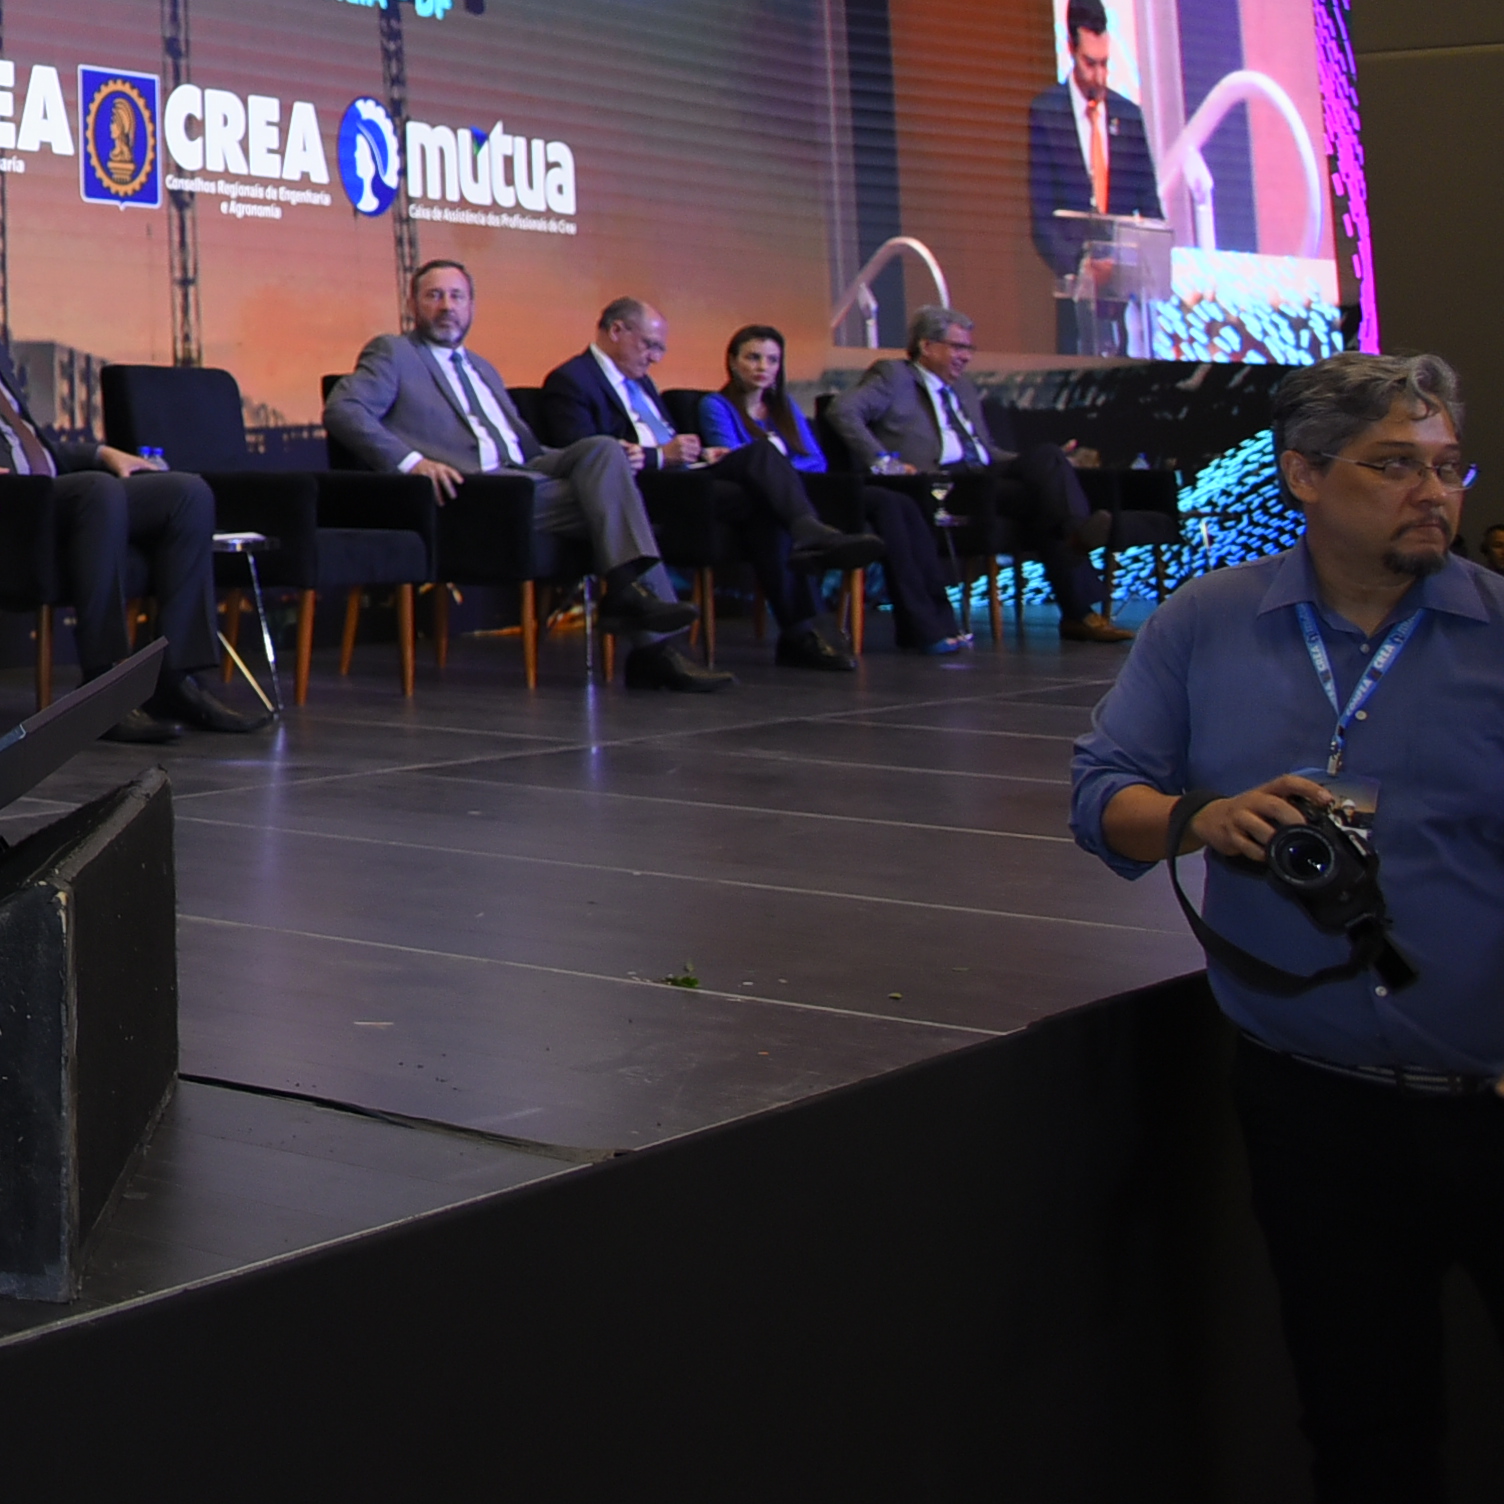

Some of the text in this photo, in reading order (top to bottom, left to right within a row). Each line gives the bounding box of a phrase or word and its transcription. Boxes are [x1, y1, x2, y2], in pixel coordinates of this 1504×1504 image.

[164, 83, 330, 185] CREA
[165, 174, 217, 194] Conselhos
[217, 179, 264, 199] Regionais
[278, 186, 332, 206] Engenharia
[220, 200, 282, 220] e Agronomia
[1373, 644, 1395, 670] CREA
